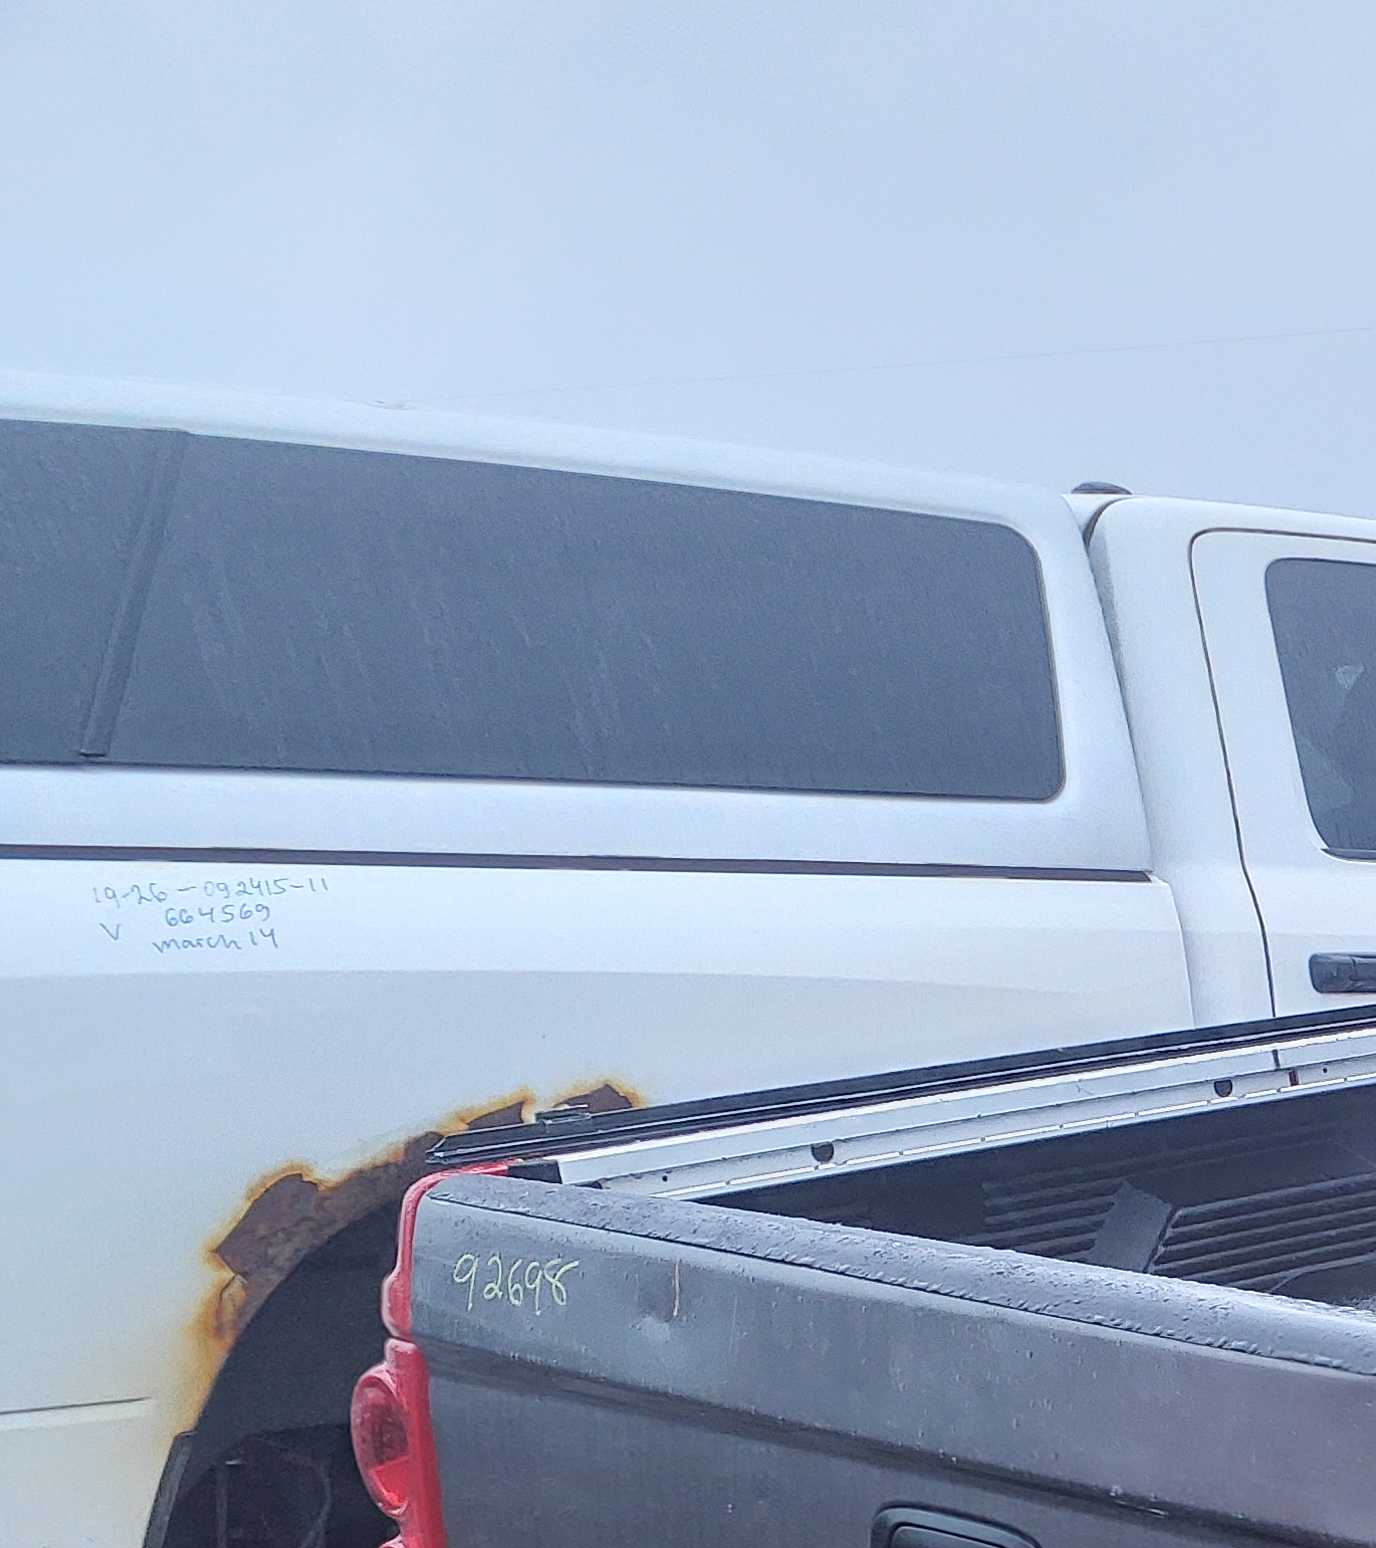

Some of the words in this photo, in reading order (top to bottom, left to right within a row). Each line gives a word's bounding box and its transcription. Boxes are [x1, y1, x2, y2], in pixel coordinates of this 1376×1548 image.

[164, 902, 271, 927] 664569
[248, 928, 280, 949] 14
[453, 1251, 581, 1316] 92698
